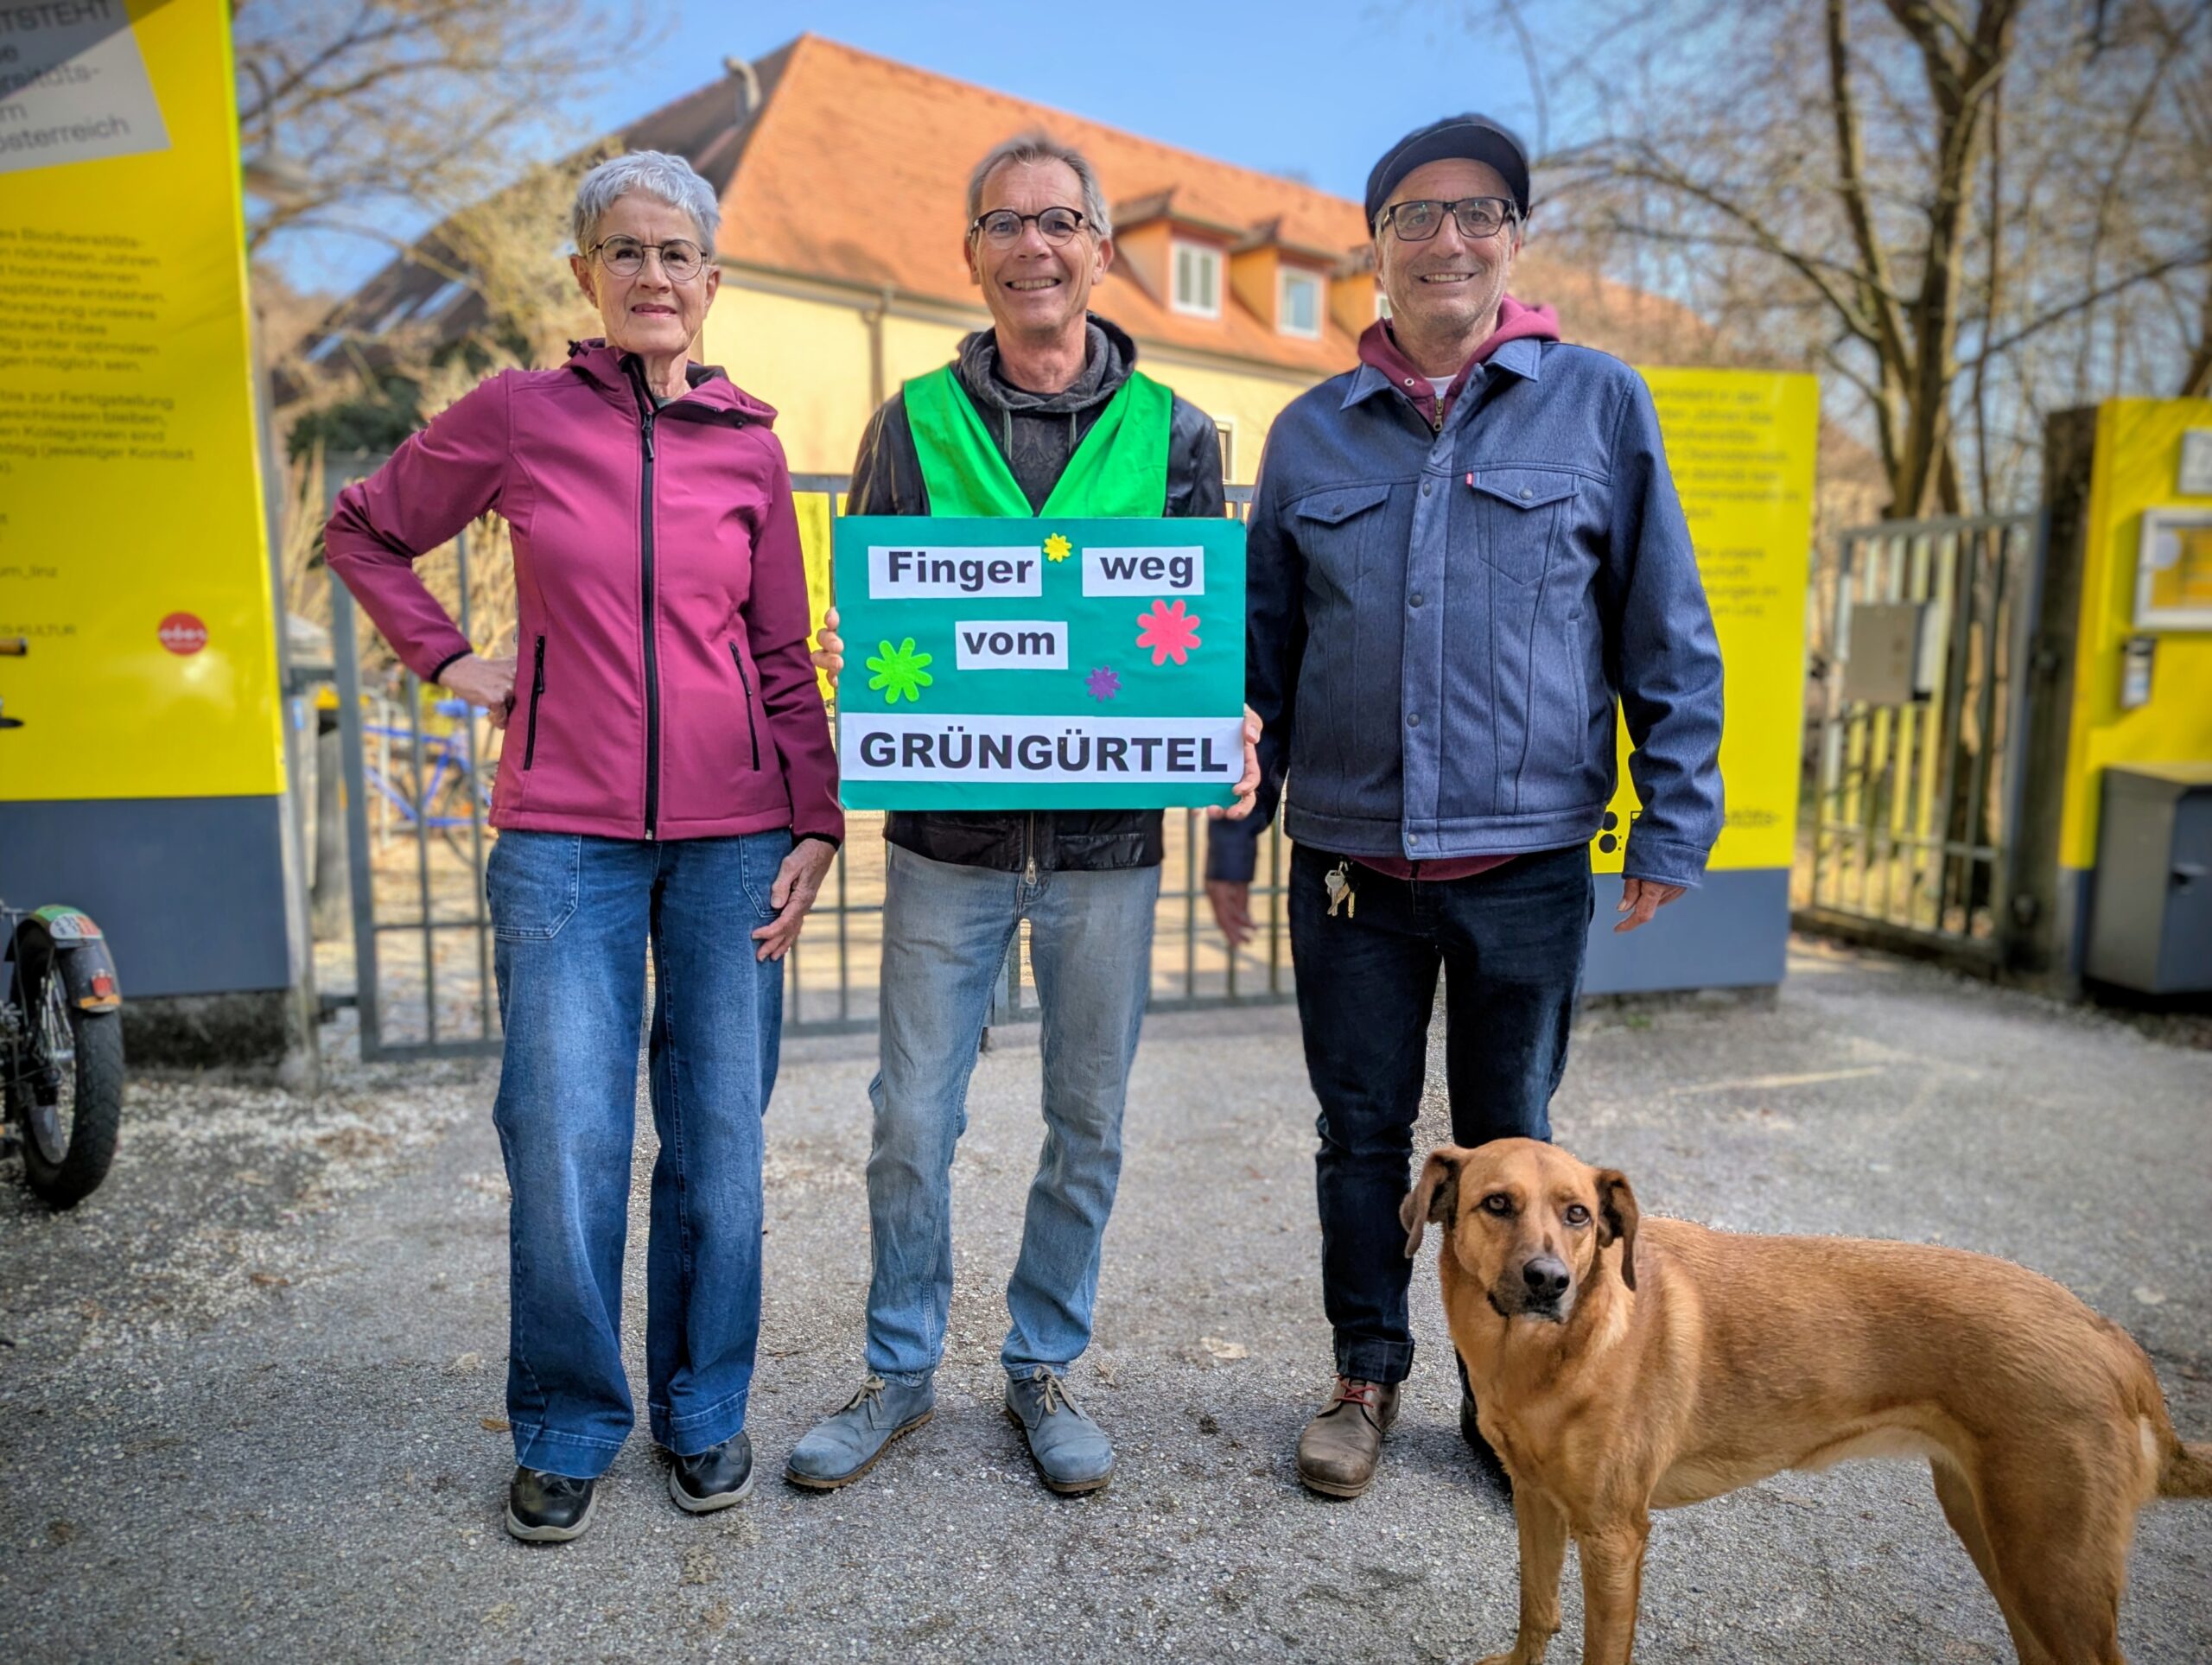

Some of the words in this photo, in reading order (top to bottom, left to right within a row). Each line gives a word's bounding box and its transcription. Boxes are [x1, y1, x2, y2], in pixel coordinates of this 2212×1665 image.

[888, 550, 1033, 592] Finger
[1100, 556, 1194, 588] weg
[963, 631, 1056, 656] vom
[859, 726, 1229, 773] GRÜNGÜRTEL
